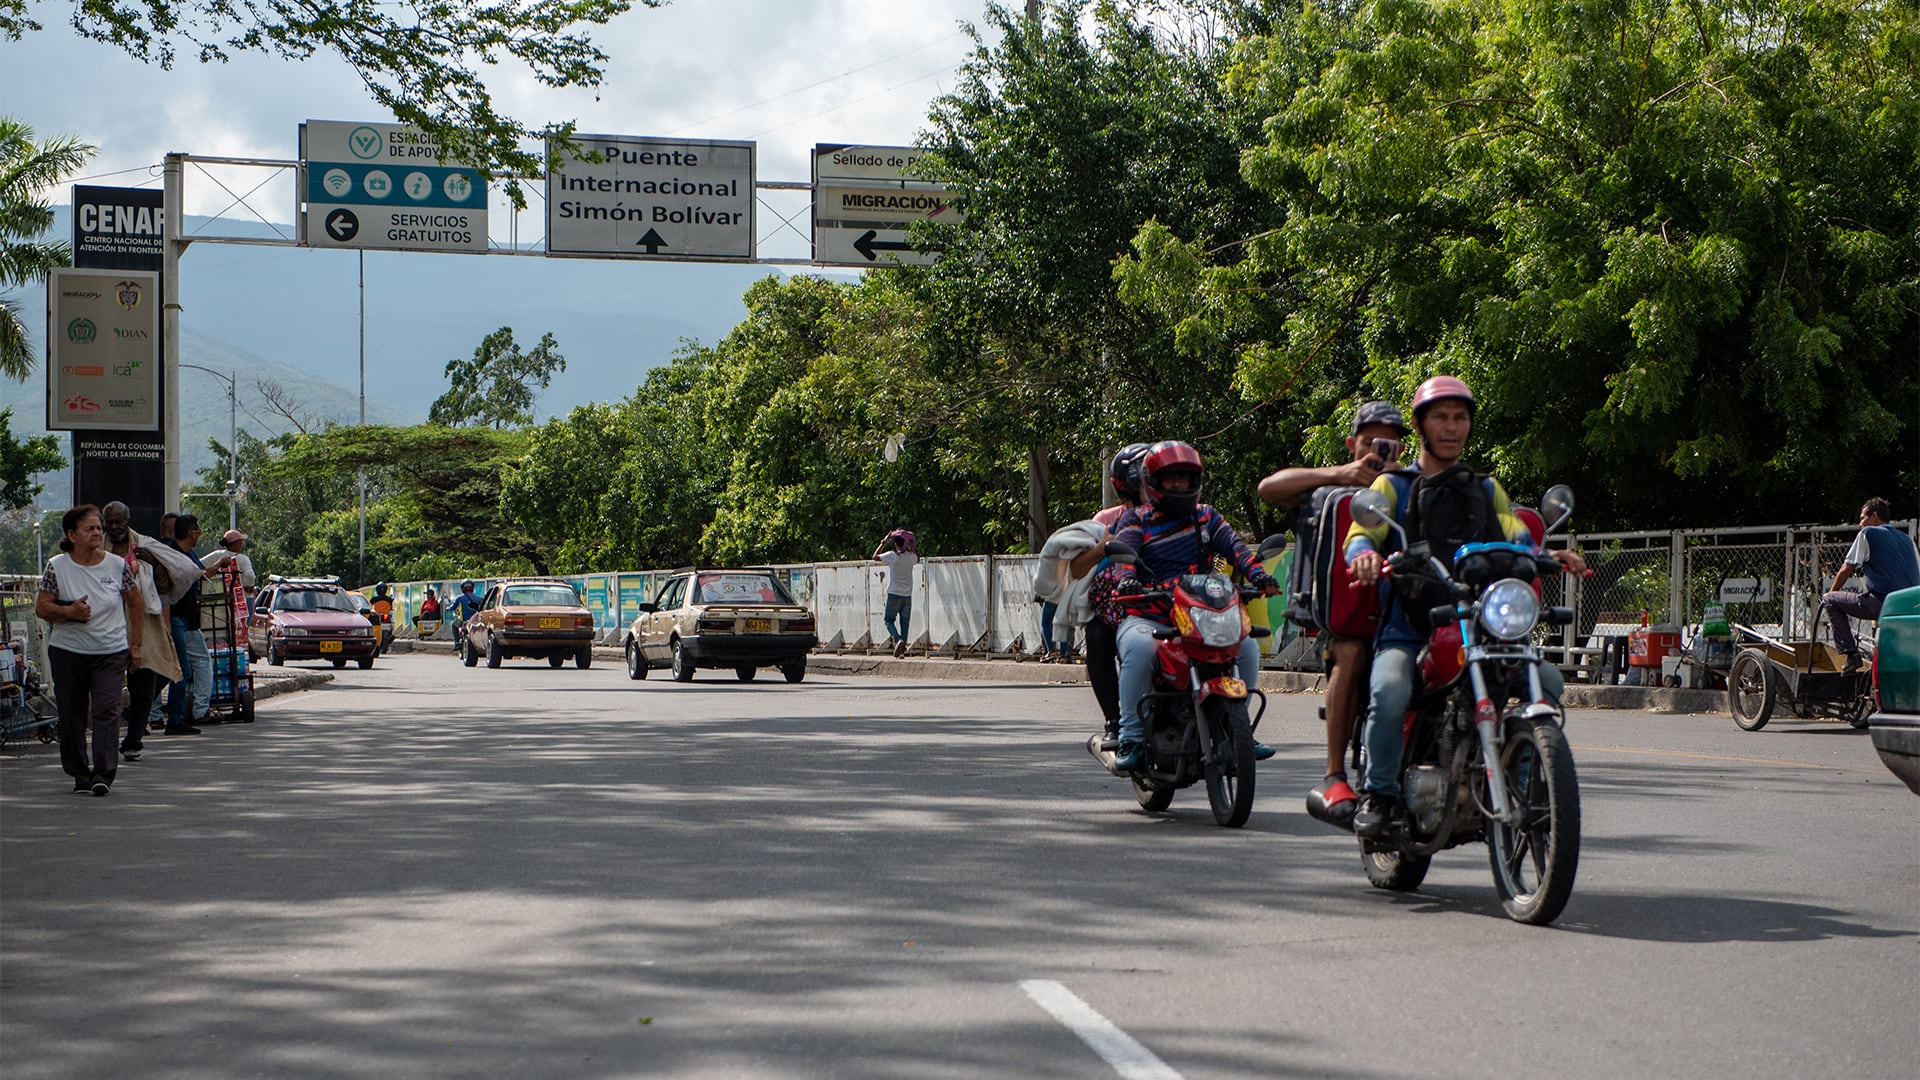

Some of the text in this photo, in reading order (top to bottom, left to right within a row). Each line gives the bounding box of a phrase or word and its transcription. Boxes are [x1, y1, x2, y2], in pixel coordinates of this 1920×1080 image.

[389, 145, 443, 159] DE APOY
[605, 146, 698, 167] Puente
[833, 153, 883, 167] Sellado
[886, 155, 904, 167] de
[560, 173, 737, 198] Internacional
[842, 193, 940, 210] MIGRACIÓN
[559, 200, 743, 226] Simón Bolívar
[391, 213, 468, 229] SERVICIOS
[84, 235, 112, 244] CENTRO
[114, 236, 152, 246] NACIONAL
[387, 228, 472, 244] GRATUITOS
[79, 244, 116, 253] ATENCIÓN
[117, 246, 128, 254] EN
[121, 328, 148, 339] DIAN
[80, 440, 164, 451] REPÚBLICA DE COLOMBIA
[86, 450, 160, 459] NORTE DE SANTANDER
